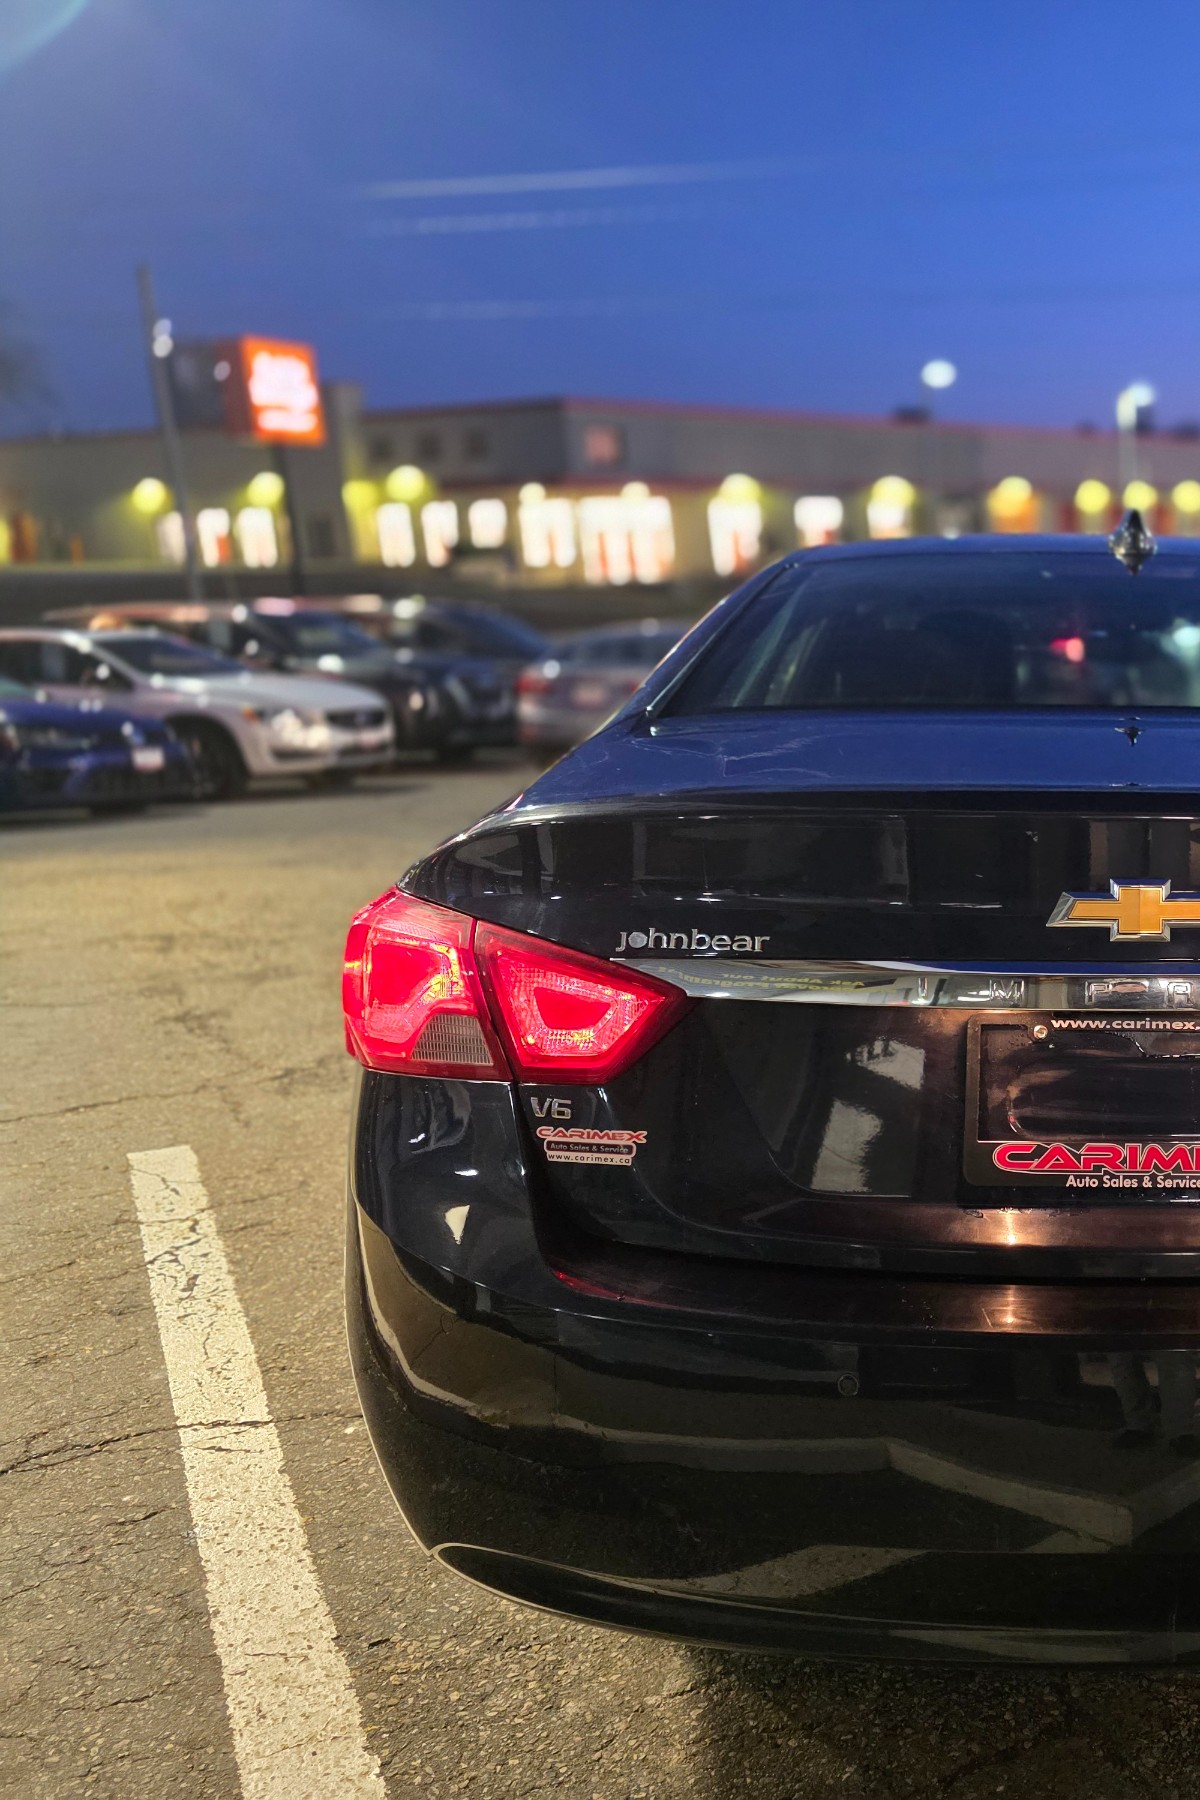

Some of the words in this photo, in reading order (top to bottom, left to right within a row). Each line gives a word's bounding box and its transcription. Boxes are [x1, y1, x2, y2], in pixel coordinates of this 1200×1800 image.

[615, 928, 770, 952] johnbear
[530, 1096, 571, 1119] V6
[537, 1126, 647, 1143] CARIMEX
[550, 1142, 568, 1151] Auto
[569, 1143, 590, 1152] Sales
[600, 1145, 629, 1154] Service
[548, 1153, 630, 1164] www.carimex.ca
[1066, 1174, 1099, 1188] Auto
[1102, 1174, 1138, 1188] Sales
[1143, 1176, 1153, 1188] &
